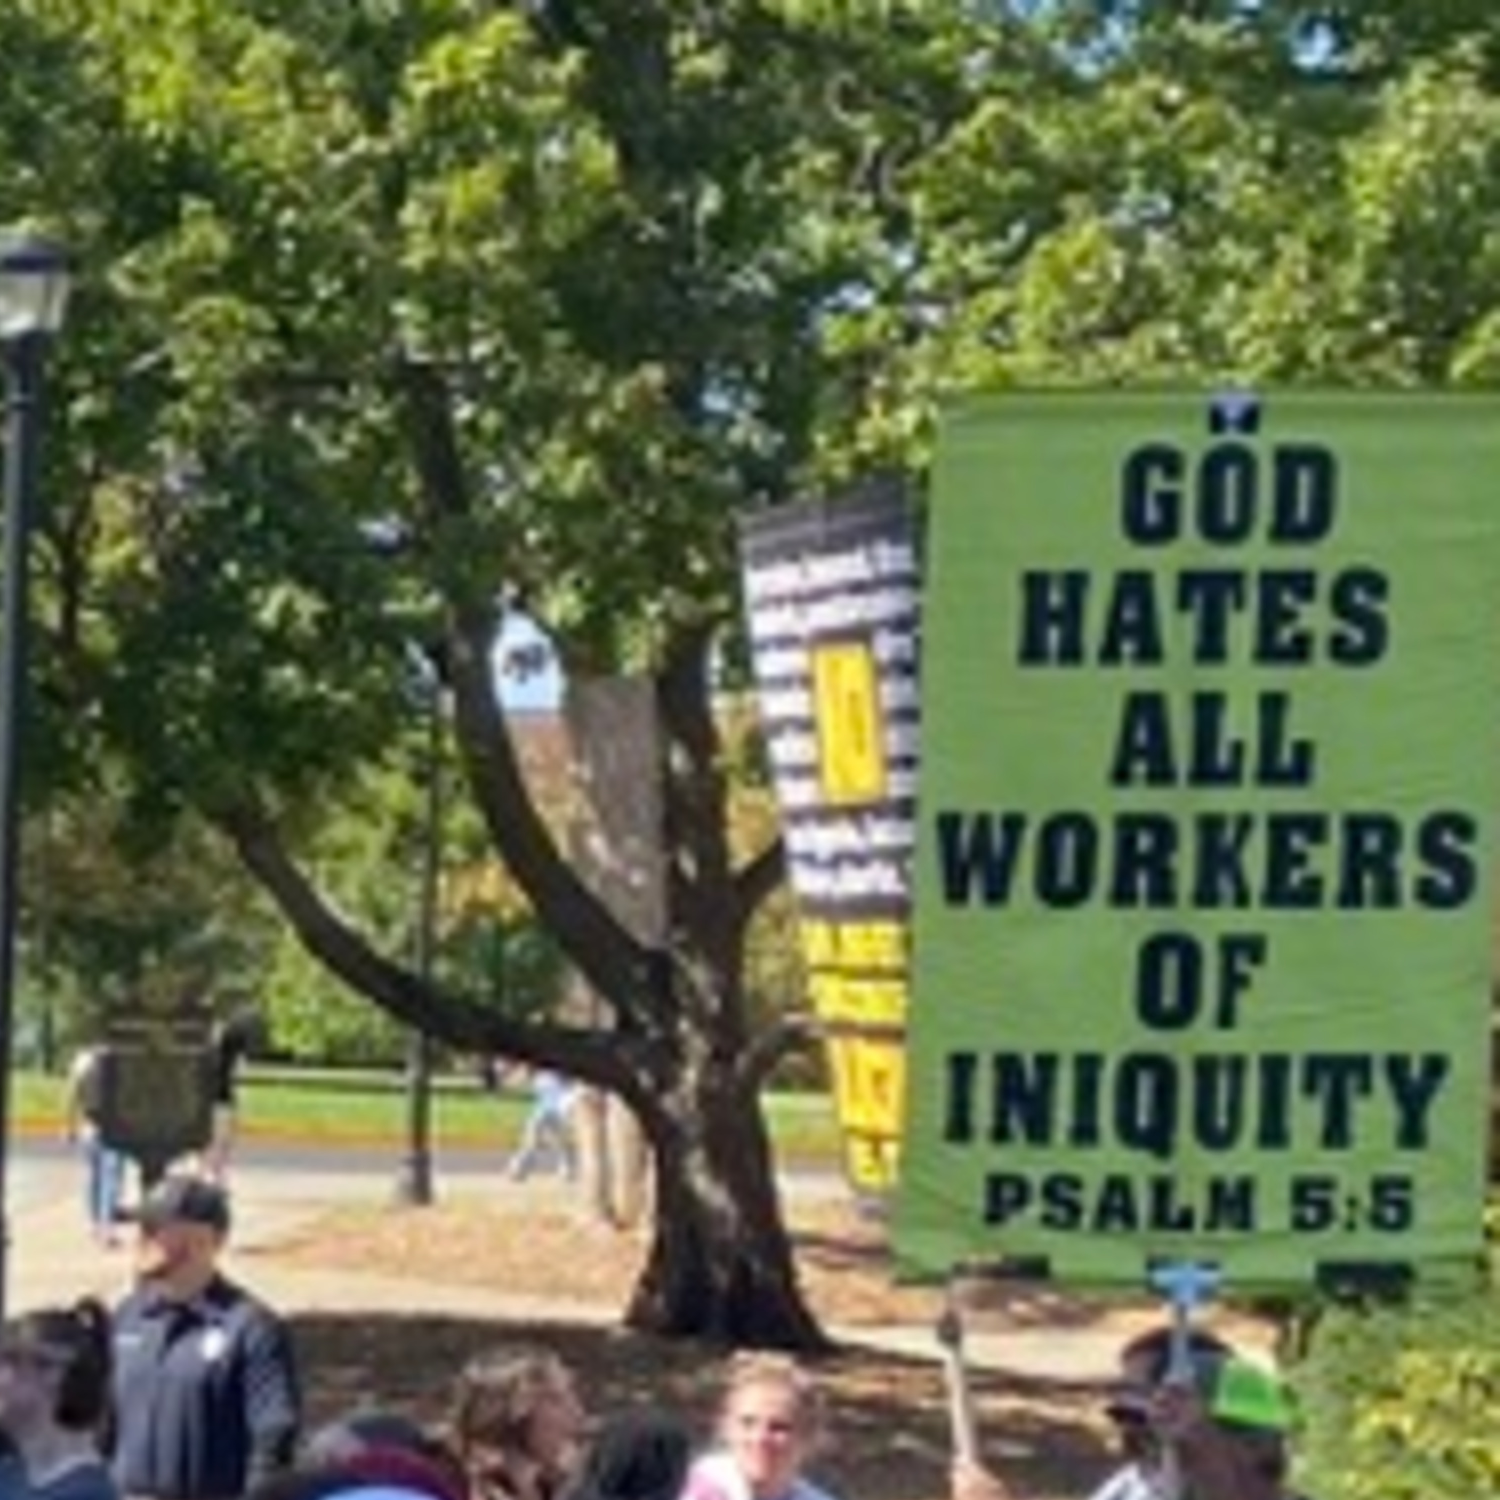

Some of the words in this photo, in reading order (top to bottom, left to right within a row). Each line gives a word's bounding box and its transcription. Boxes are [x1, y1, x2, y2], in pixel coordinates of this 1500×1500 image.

[1122, 443, 1338, 545] GOD
[1018, 567, 1390, 666] HATES
[1109, 690, 1315, 788] ALL
[937, 811, 1480, 910] WORKERS
[1137, 933, 1267, 1031] OF
[944, 1052, 1451, 1160] INIQUITY
[984, 1174, 1257, 1233] PSALM
[1291, 1176, 1414, 1233] 5:5
